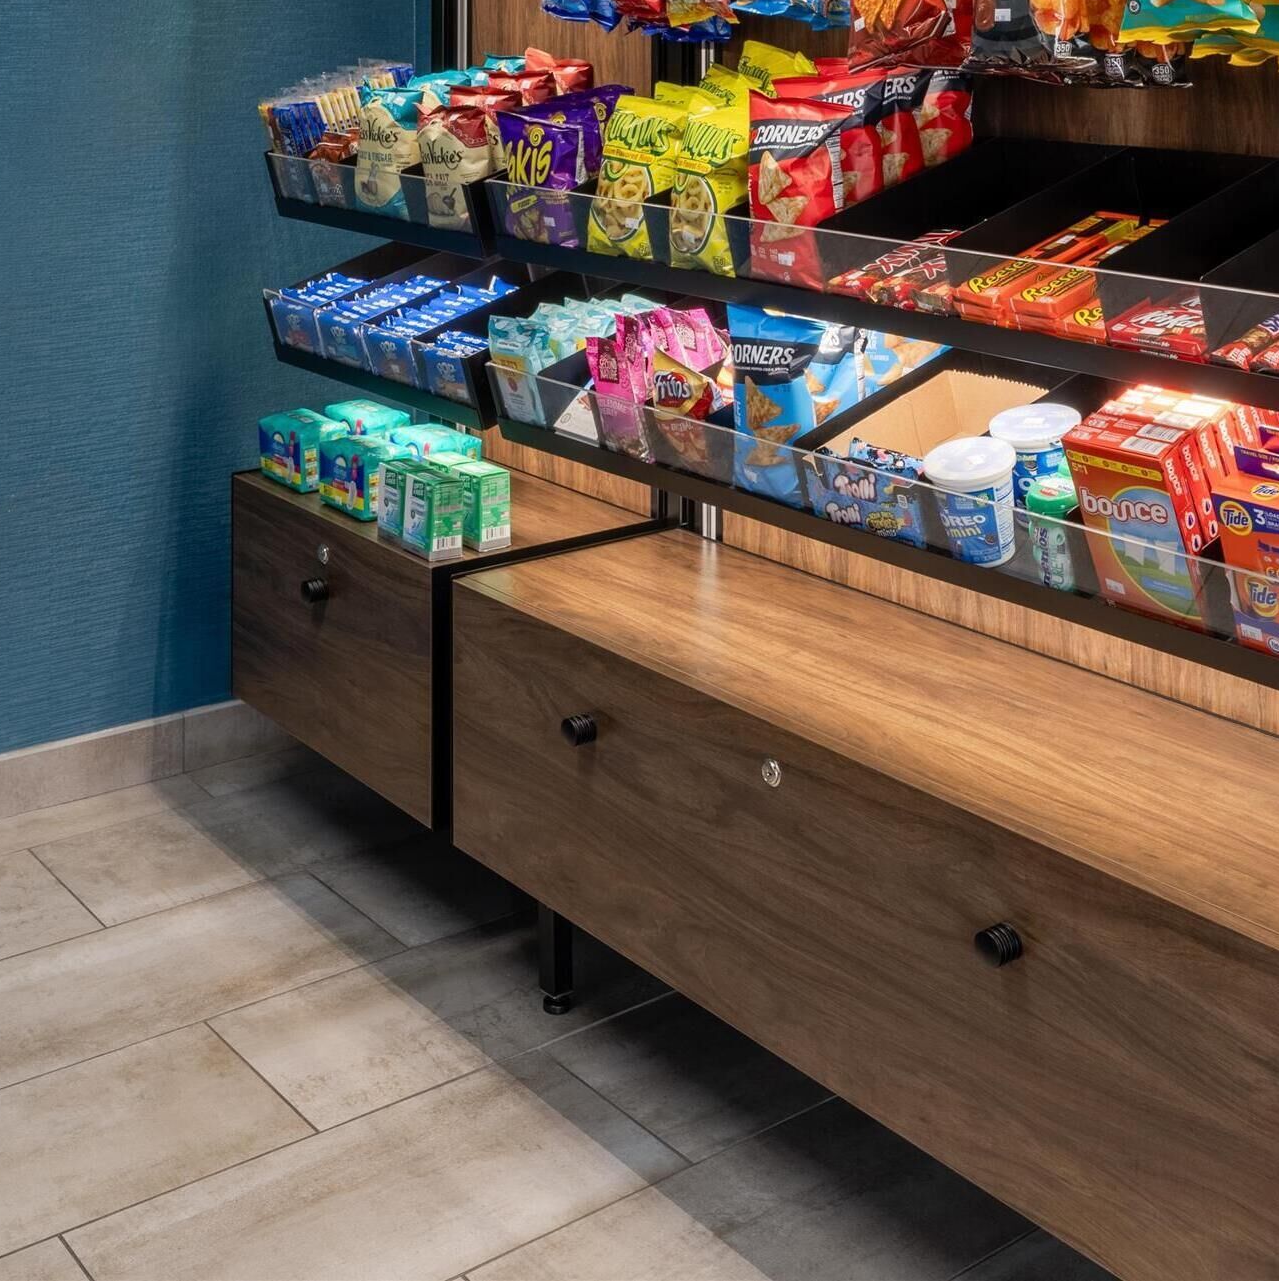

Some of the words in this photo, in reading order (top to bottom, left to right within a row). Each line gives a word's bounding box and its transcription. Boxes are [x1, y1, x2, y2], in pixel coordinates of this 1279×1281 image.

[1056, 42, 1071, 53] 350
[754, 124, 828, 145] CORNERS
[507, 139, 553, 187] akis
[1182, 446, 1200, 482] bounce
[834, 473, 877, 500] Trolli
[1165, 458, 1183, 497] bounce
[1254, 483, 1279, 496] Tide
[825, 503, 863, 524] Trolli
[1079, 485, 1169, 523] bounce
[940, 513, 987, 528] OREO
[1223, 508, 1249, 526] Tide
[1253, 508, 1266, 525] 3
[1248, 582, 1278, 606] Tide
